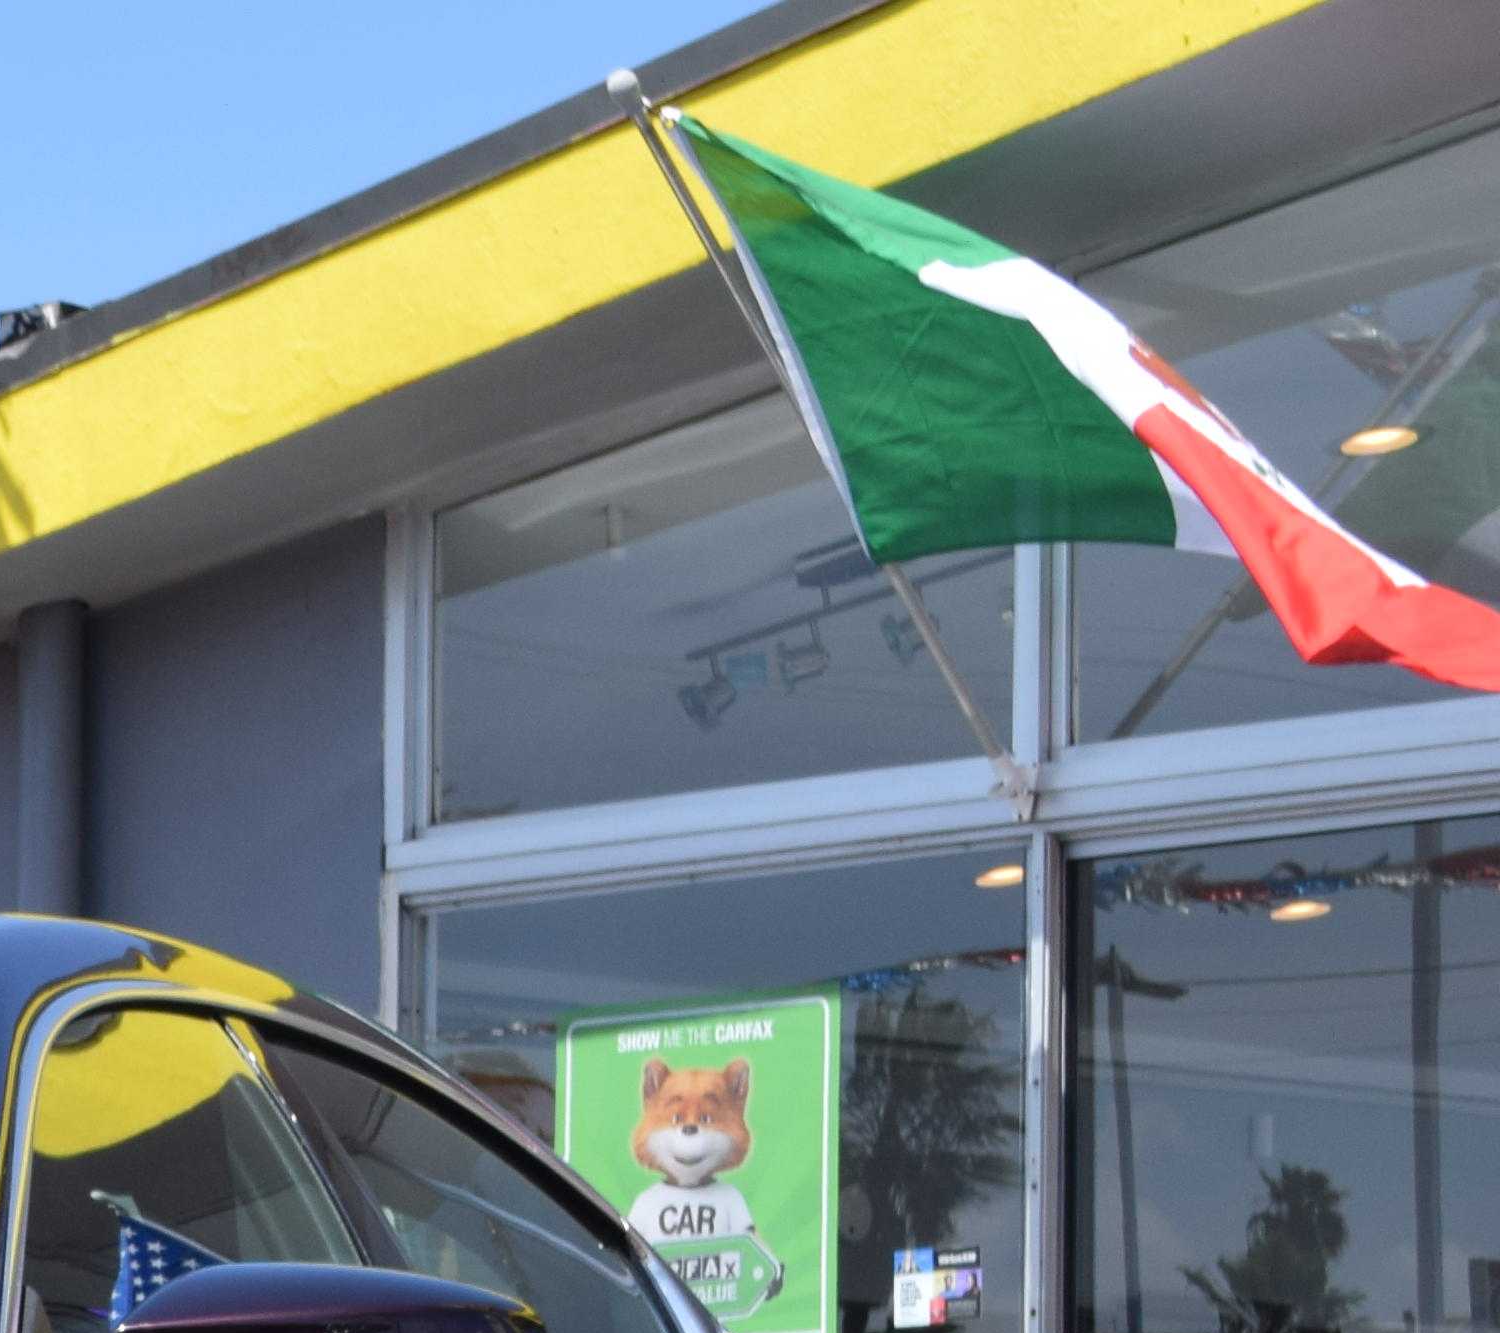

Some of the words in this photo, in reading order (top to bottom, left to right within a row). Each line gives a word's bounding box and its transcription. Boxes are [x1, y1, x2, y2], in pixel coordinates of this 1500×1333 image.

[618, 1029, 661, 1052] SHOW
[715, 1018, 773, 1044] CARFAX
[658, 1204, 717, 1235] CAR
